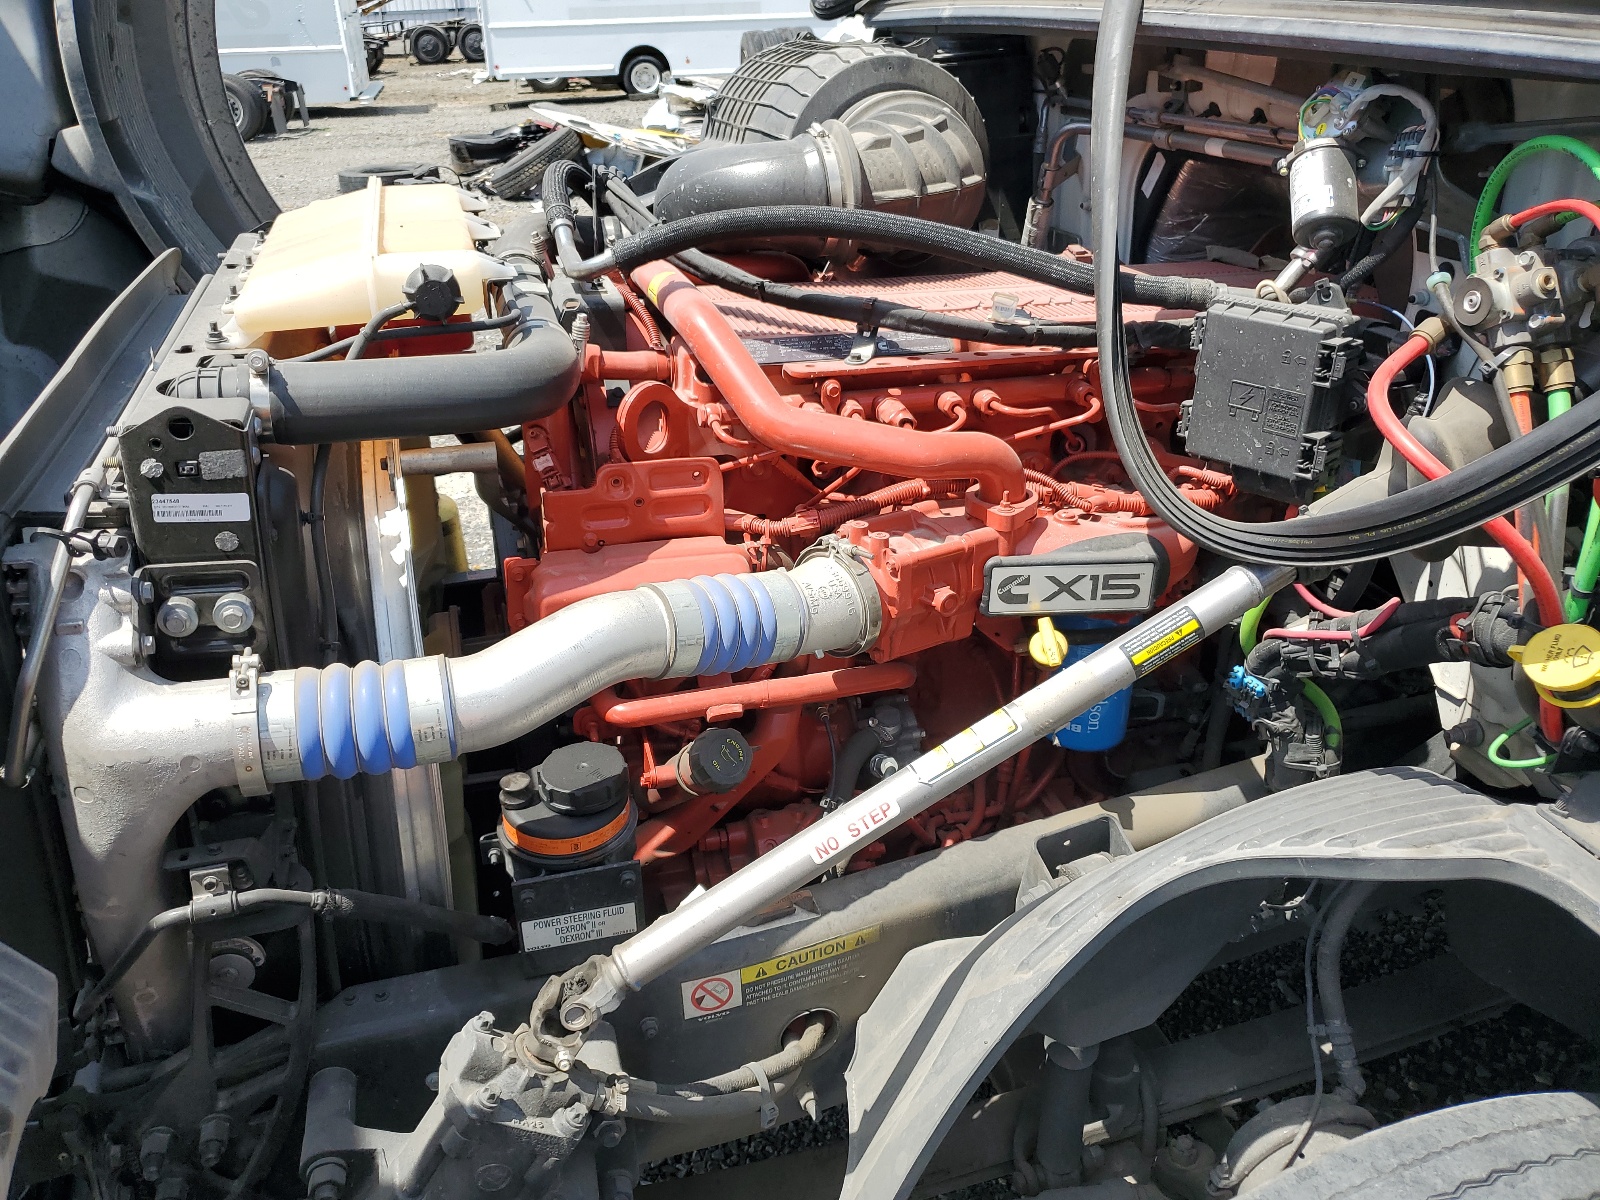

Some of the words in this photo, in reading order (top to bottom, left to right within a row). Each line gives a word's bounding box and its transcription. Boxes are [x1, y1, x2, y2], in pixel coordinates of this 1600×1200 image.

[726, 738, 744, 761] ENGINE
[712, 760, 721, 771] OIL
[815, 836, 840, 860] NO
[847, 802, 891, 838] STEP
[533, 918, 562, 930] POWER
[563, 910, 601, 924] STEERING
[603, 906, 625, 918] FLUID
[776, 940, 846, 971] CAUTION
[745, 986, 754, 994] DO
[745, 987, 773, 1001] ATTACHED
[697, 1011, 731, 1021] VOLVO
